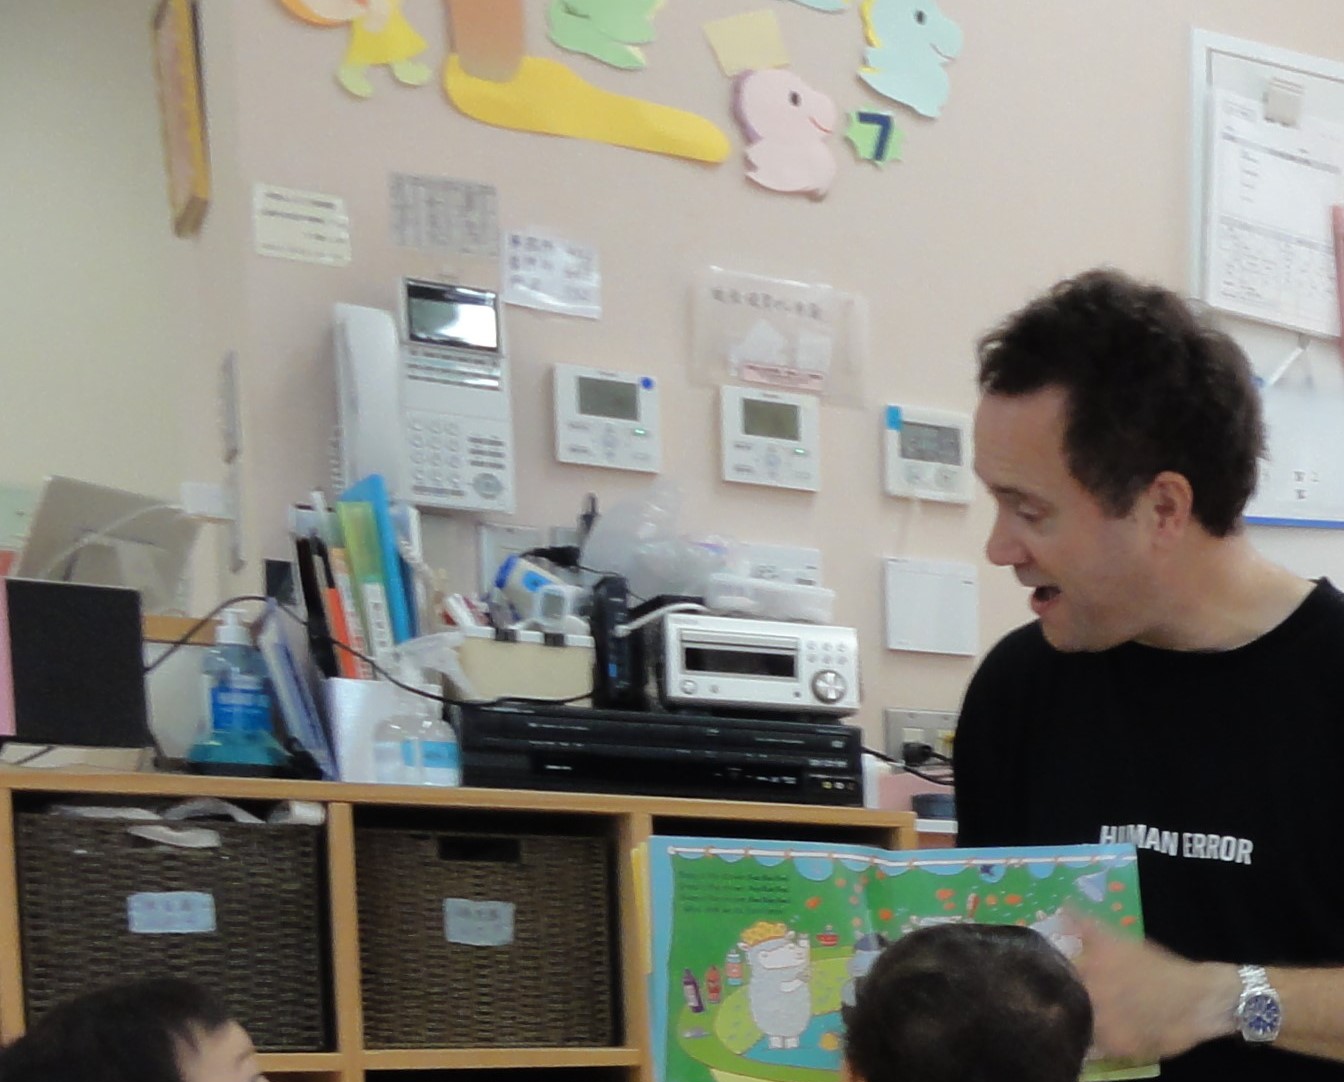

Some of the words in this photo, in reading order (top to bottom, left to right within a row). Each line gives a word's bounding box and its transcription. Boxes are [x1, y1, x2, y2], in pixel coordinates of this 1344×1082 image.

[858, 112, 892, 161] 7
[1101, 824, 1178, 856] HUMAN
[1183, 832, 1254, 865] ERROR
